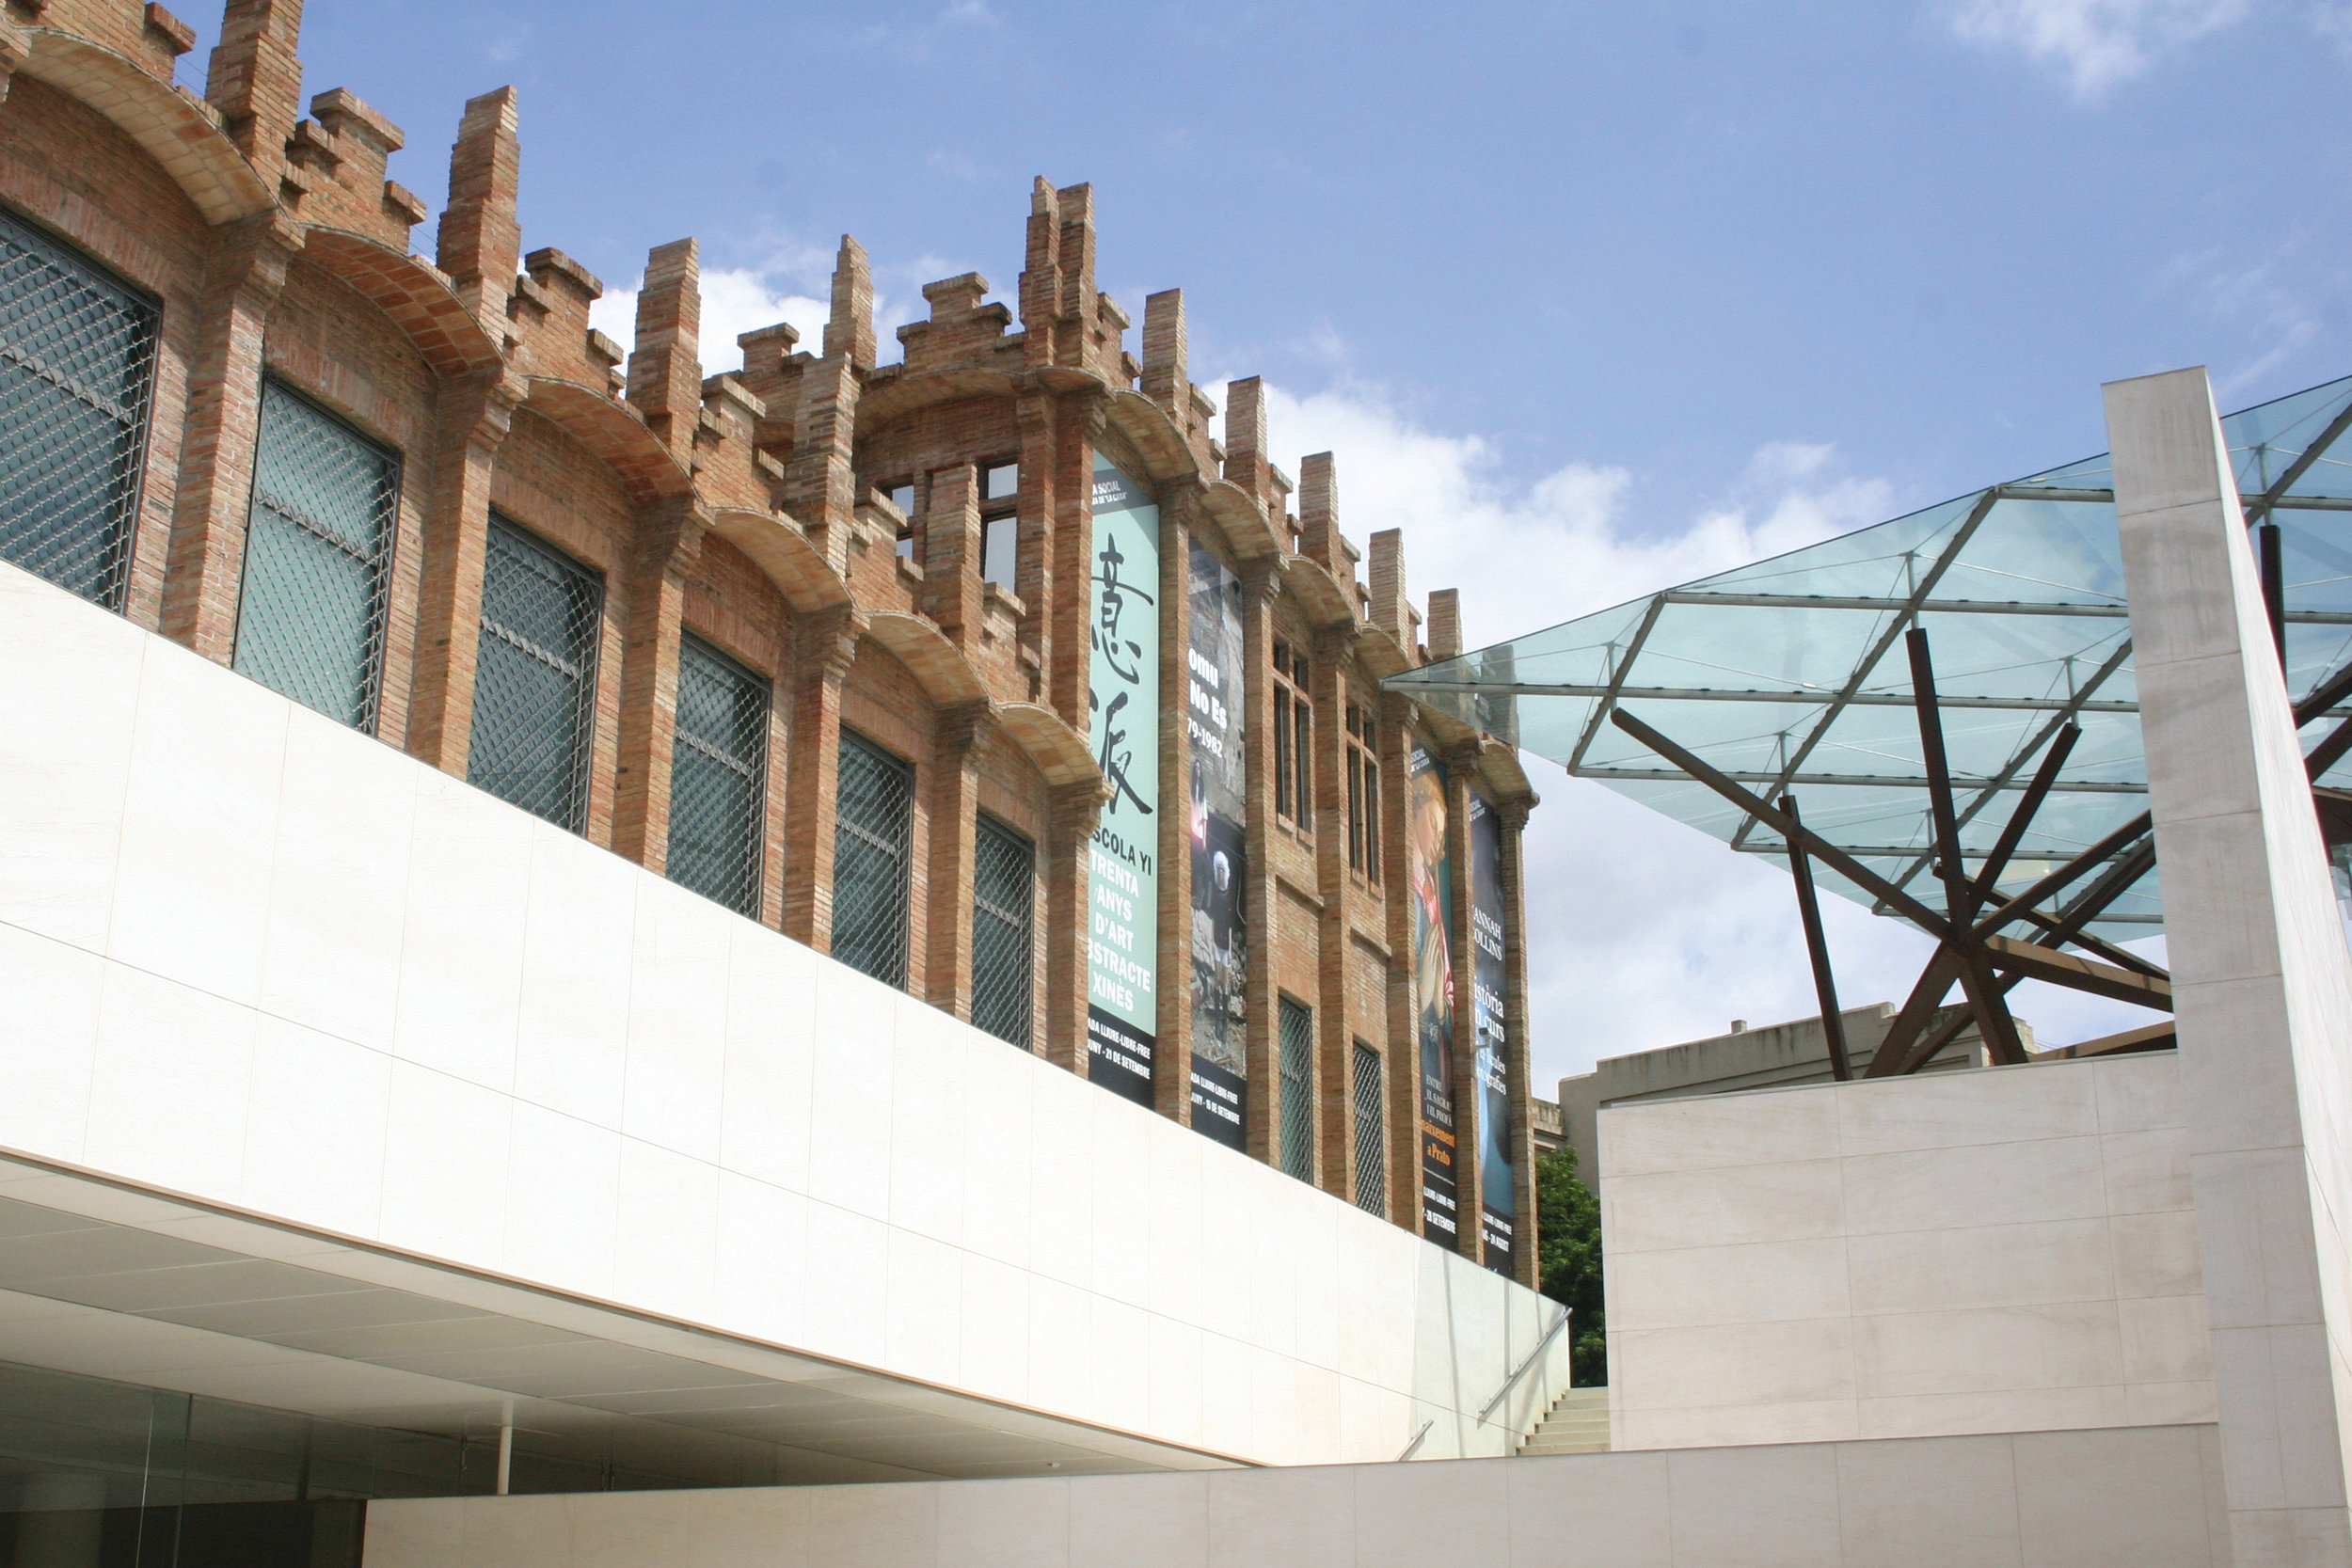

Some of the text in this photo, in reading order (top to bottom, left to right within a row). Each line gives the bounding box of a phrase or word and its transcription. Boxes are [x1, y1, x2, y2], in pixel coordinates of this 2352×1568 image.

[1090, 848, 1139, 897] TRENTA
[1139, 850, 1152, 876] YI
[1096, 883, 1132, 922] ANYS
[1095, 912, 1134, 952] D'ART
[1471, 904, 1502, 941] ANNAH
[1473, 927, 1502, 961] OLLINS
[1092, 971, 1134, 1012] XINÈS
[1484, 1015, 1505, 1042] curs
[1112, 1051, 1120, 1065] DE
